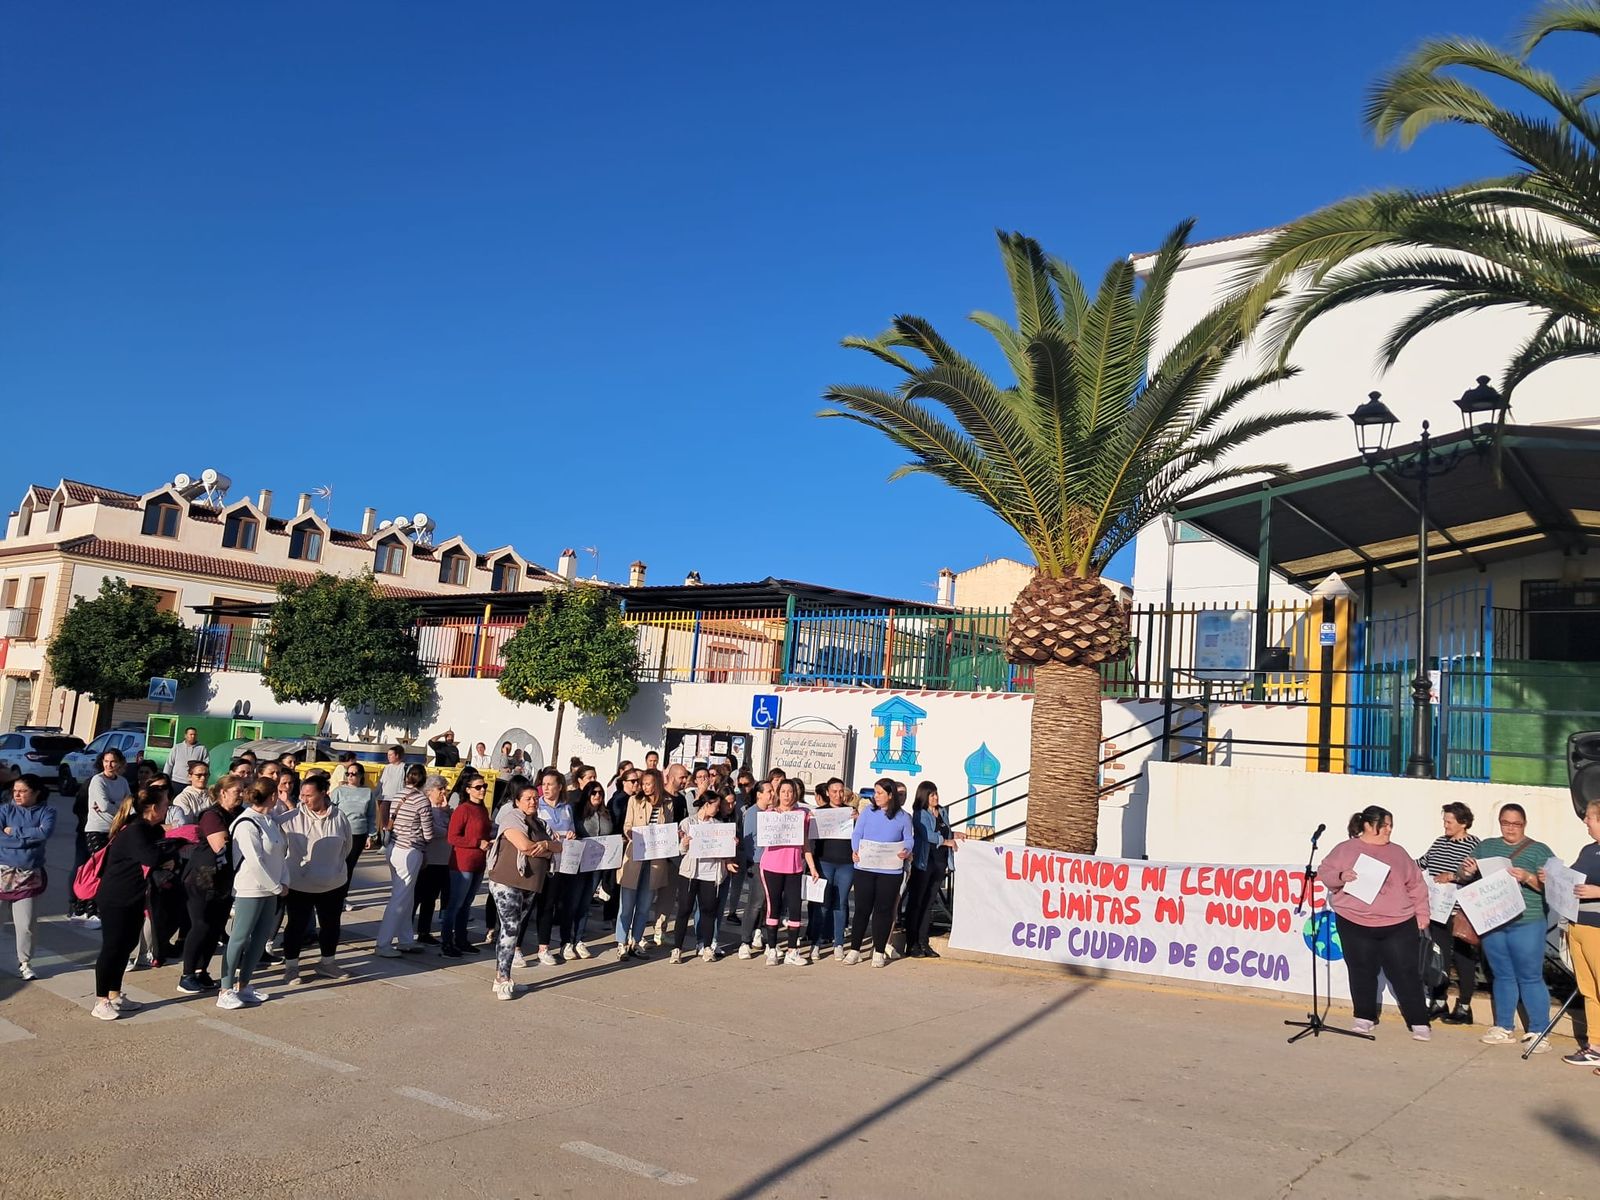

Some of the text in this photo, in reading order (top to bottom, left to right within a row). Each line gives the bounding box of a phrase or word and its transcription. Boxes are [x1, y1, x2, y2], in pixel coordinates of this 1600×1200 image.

[780, 737, 837, 749] Colegio de Educación
[782, 748, 803, 756] Infantil
[804, 759, 812, 768] de
[1141, 866, 1169, 892] MI
[1180, 866, 1326, 908] LENGUAJE
[1042, 886, 1141, 925] LIMITAS
[1154, 895, 1185, 925] MI
[1012, 921, 1290, 982] CEIP CIUDAD DE OSCUA
